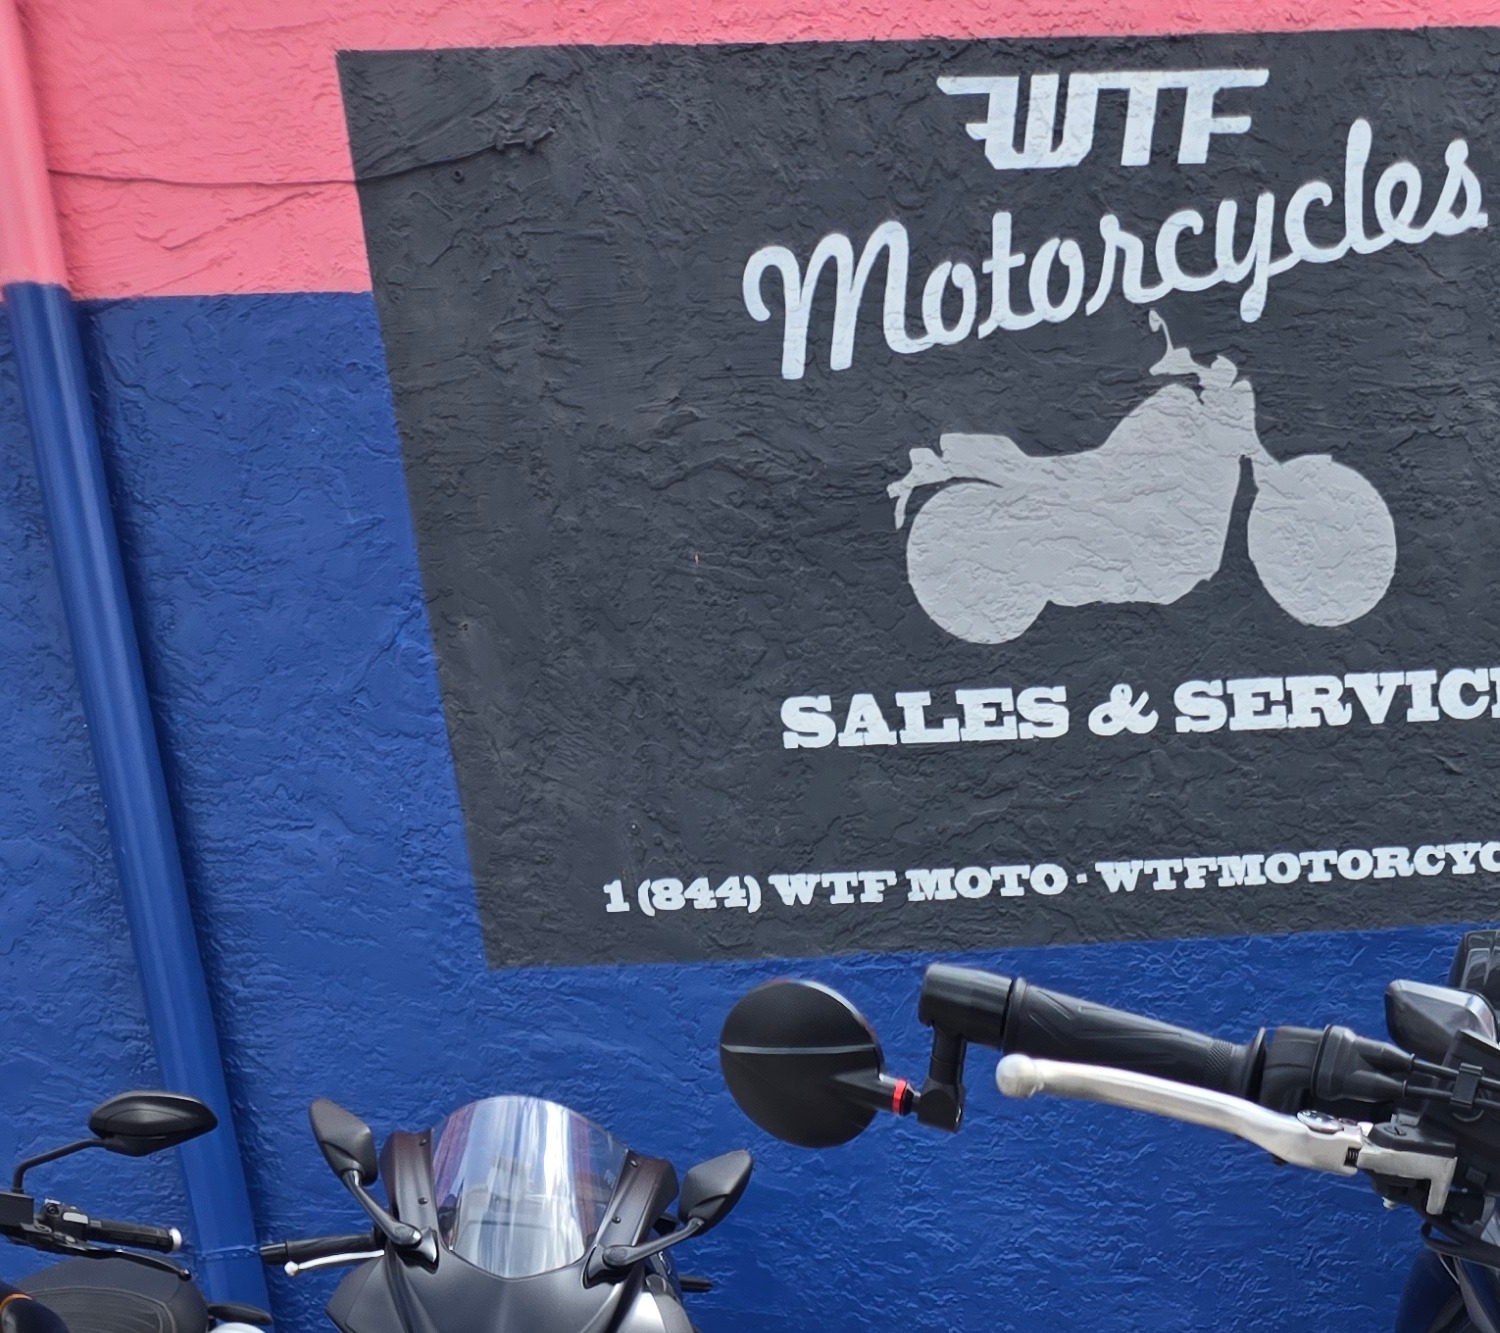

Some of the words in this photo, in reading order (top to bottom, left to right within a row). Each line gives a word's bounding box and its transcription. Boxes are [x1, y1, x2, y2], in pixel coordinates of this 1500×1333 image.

[936, 67, 1270, 170] WTF
[742, 118, 1489, 380] Motorcycles
[780, 685, 1070, 749] SALES
[1087, 683, 1159, 736] &
[603, 879, 630, 913] 1
[636, 874, 762, 917] (844)
[767, 871, 899, 906] WTF
[904, 863, 1069, 902] MOTO
